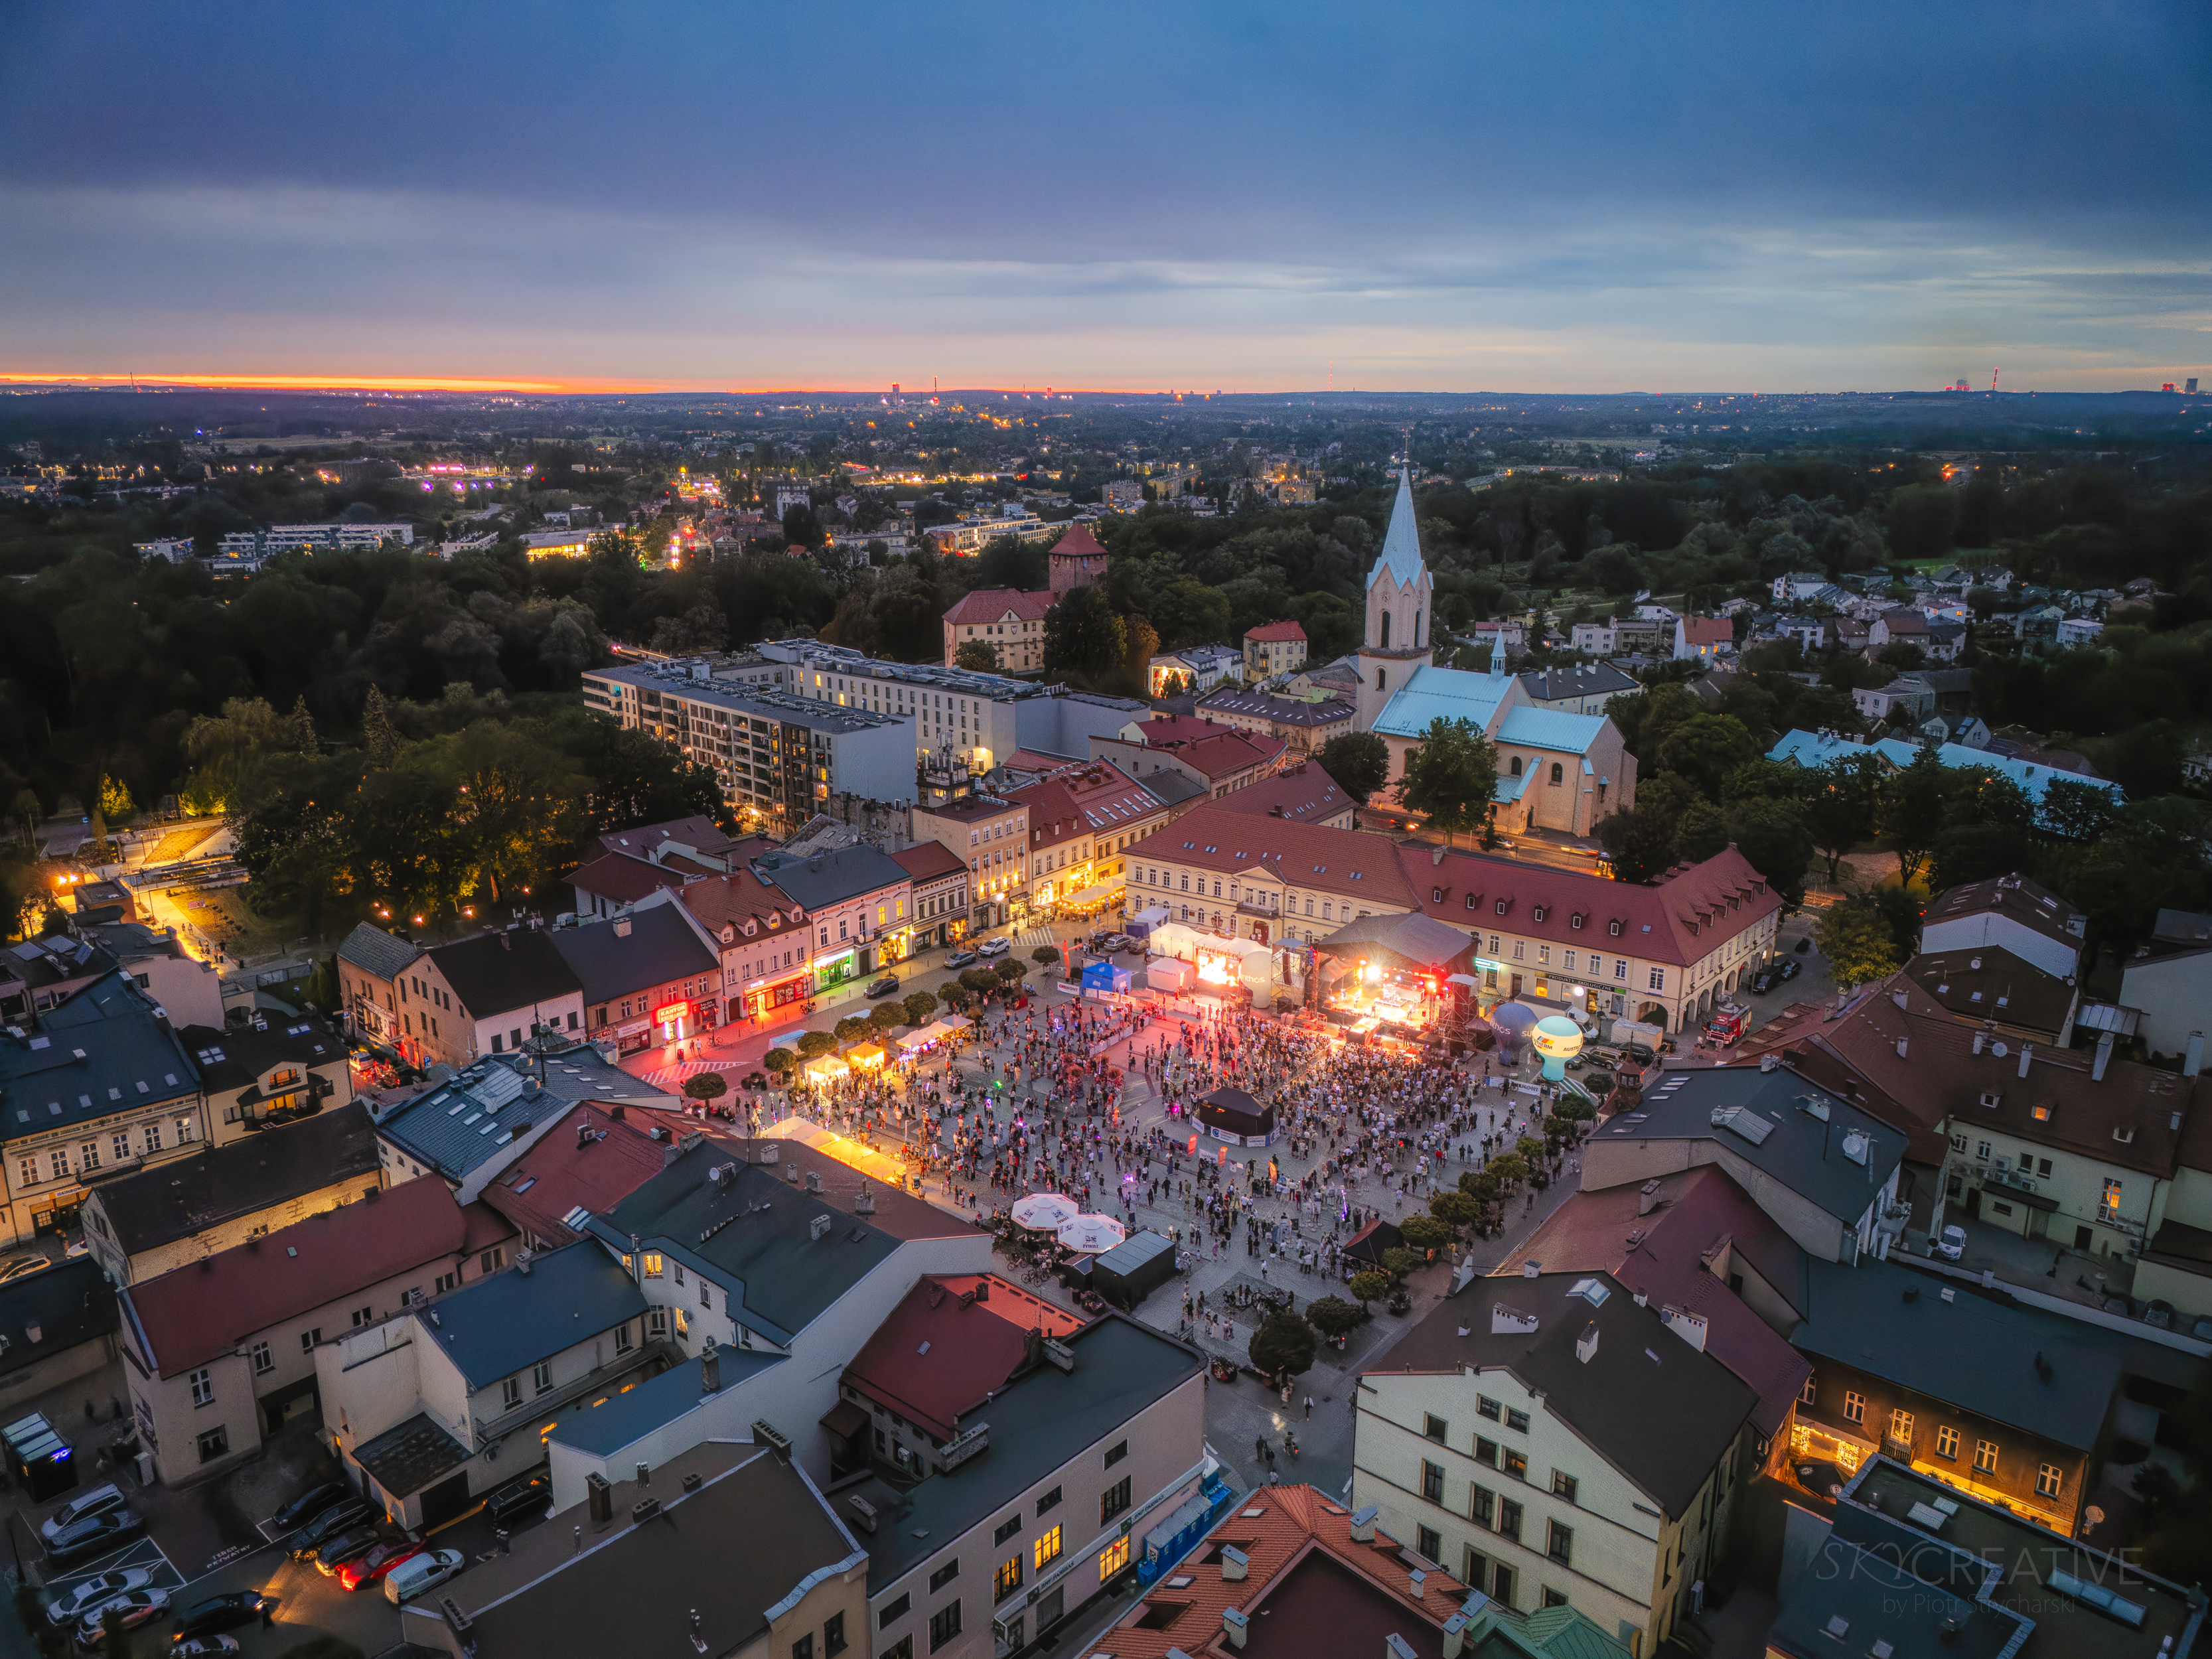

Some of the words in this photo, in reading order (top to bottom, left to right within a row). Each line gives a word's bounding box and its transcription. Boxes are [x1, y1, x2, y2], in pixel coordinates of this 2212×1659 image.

[1548, 974, 1574, 983] PRODUKTY
[1578, 981, 1611, 991] EKOLOGICZNE
[660, 1005, 686, 1017] KANTOR
